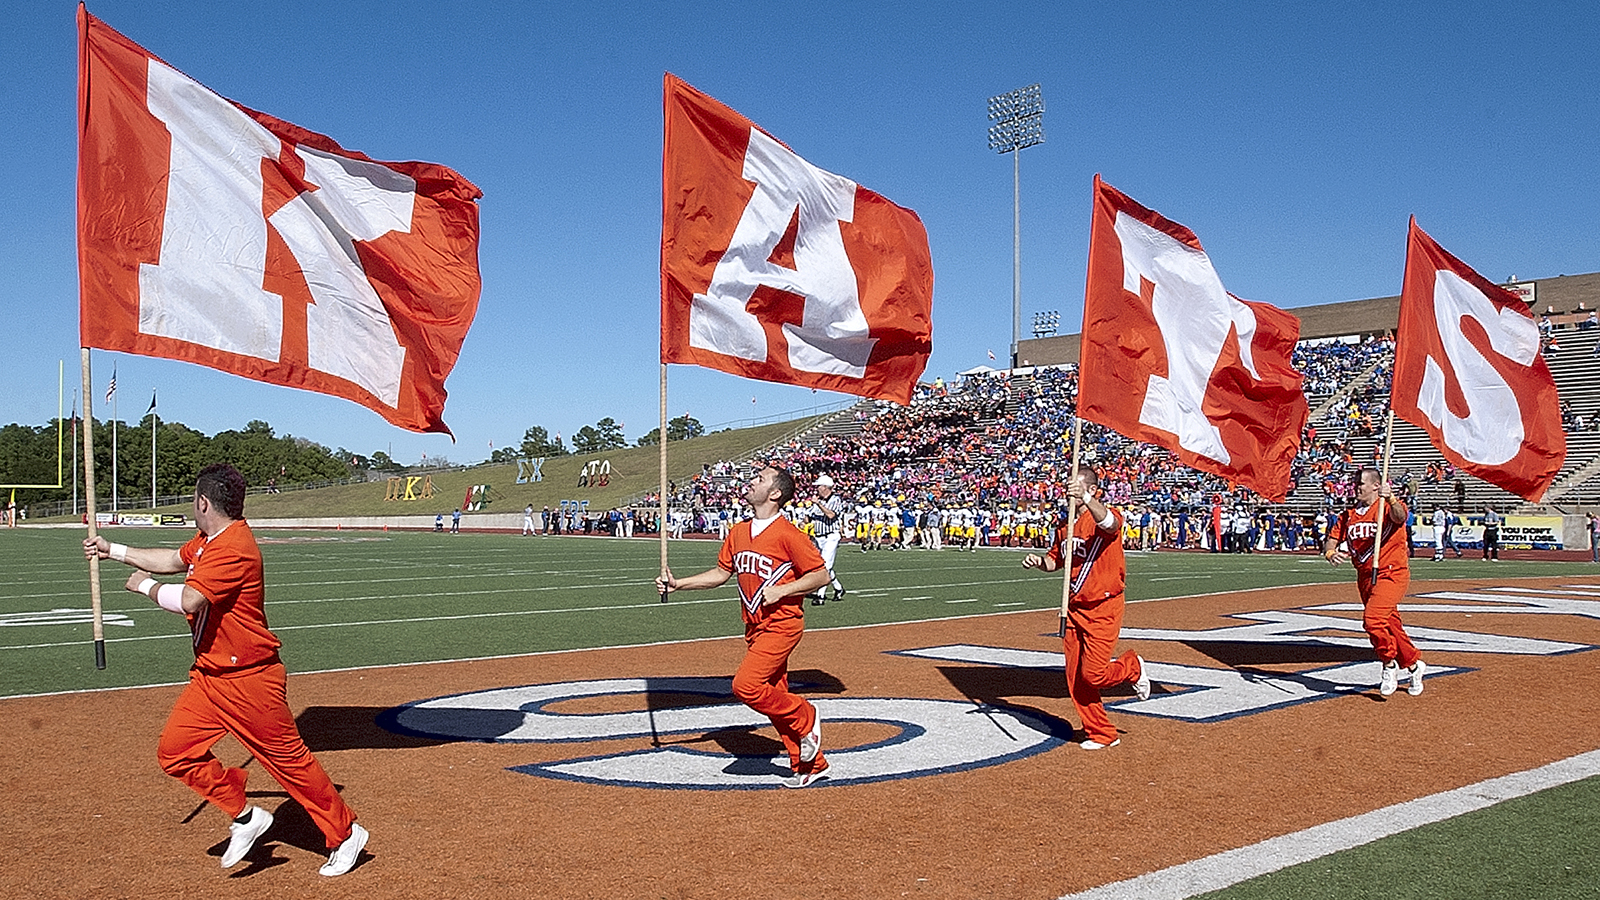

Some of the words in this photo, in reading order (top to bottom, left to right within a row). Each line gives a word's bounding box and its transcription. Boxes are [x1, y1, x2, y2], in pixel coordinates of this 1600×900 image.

[139, 57, 416, 410] K
[689, 126, 880, 379] A
[1416, 269, 1541, 467] S
[733, 551, 773, 580] KATS
